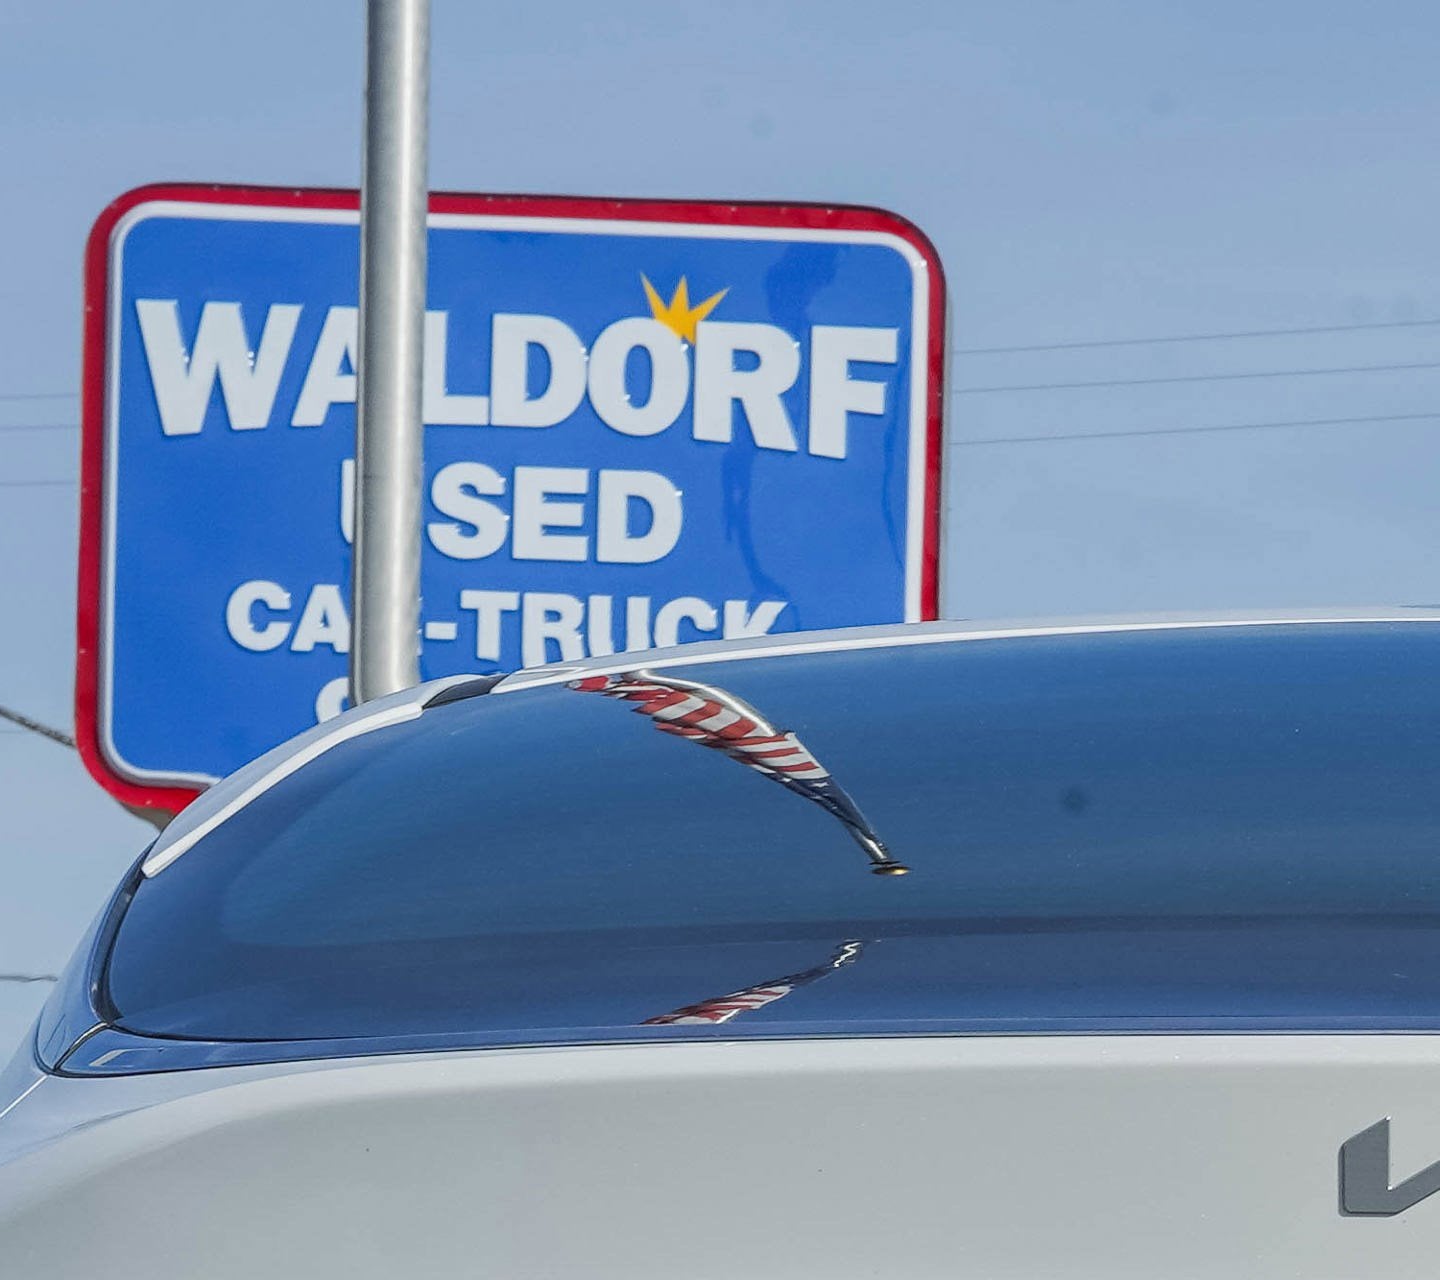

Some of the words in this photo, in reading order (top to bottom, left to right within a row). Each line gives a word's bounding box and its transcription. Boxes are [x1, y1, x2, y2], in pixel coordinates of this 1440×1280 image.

[135, 298, 900, 459] WALDORF
[341, 461, 683, 564] SED
[225, 580, 788, 669] CA-TRUCK
